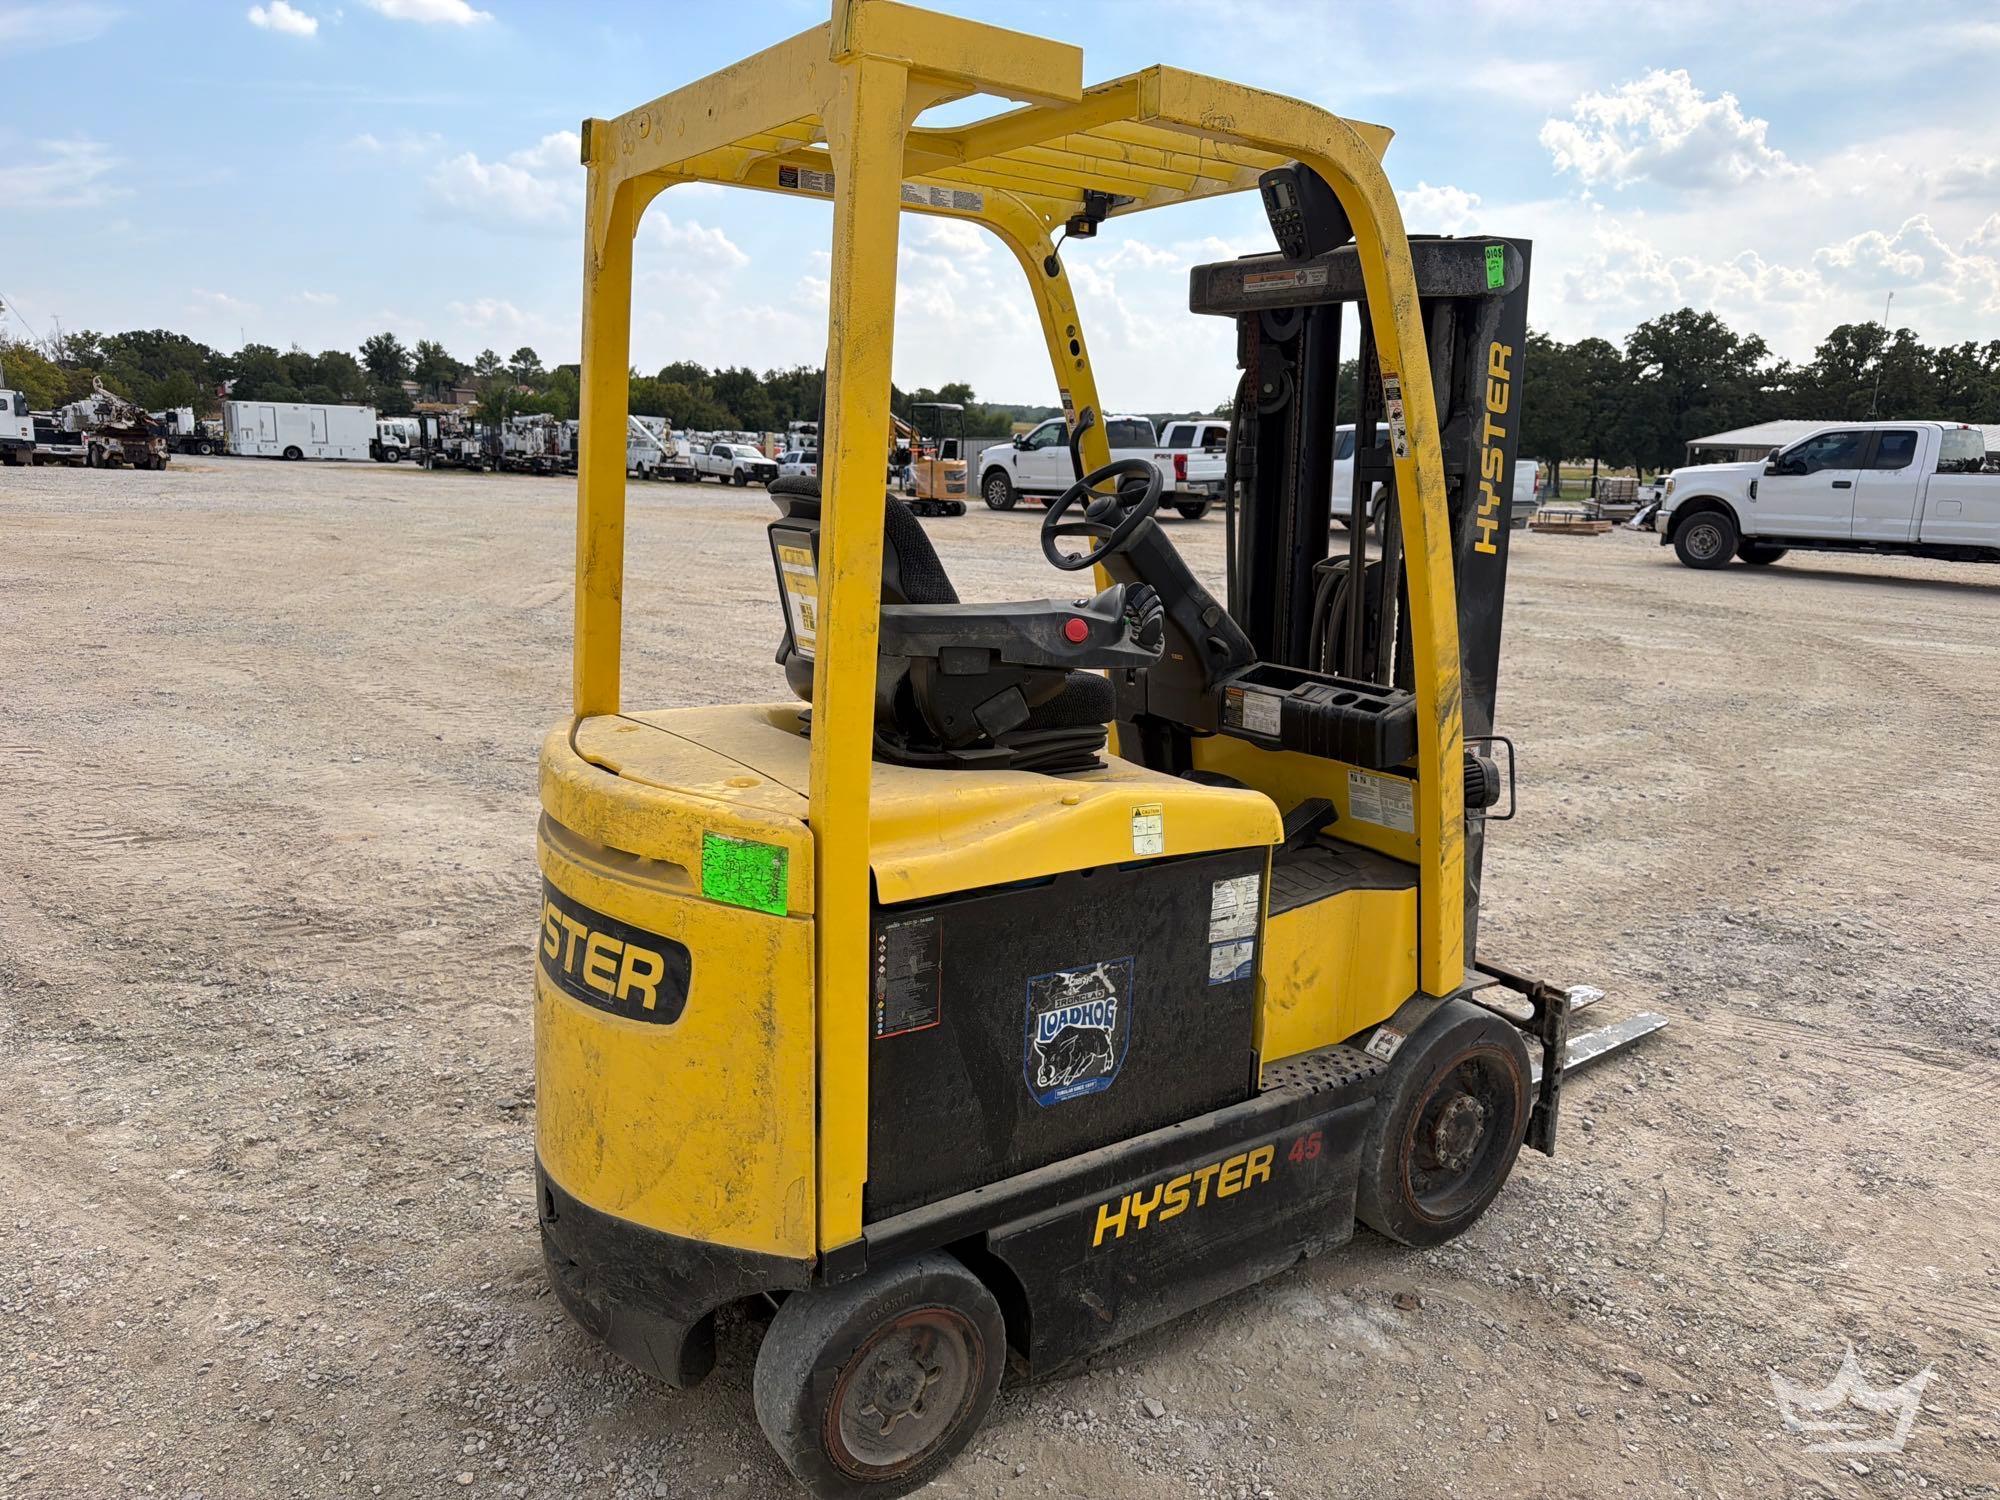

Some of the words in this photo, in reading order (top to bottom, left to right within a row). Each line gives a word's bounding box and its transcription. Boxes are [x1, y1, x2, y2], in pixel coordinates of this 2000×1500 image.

[1474, 341, 1512, 555] HYSTER
[1039, 997, 1117, 1042] LOADHOG
[1056, 990, 1103, 1007] IRONCLAD
[1092, 1144, 1275, 1248] HYSTER
[1288, 1131, 1323, 1162] 45
